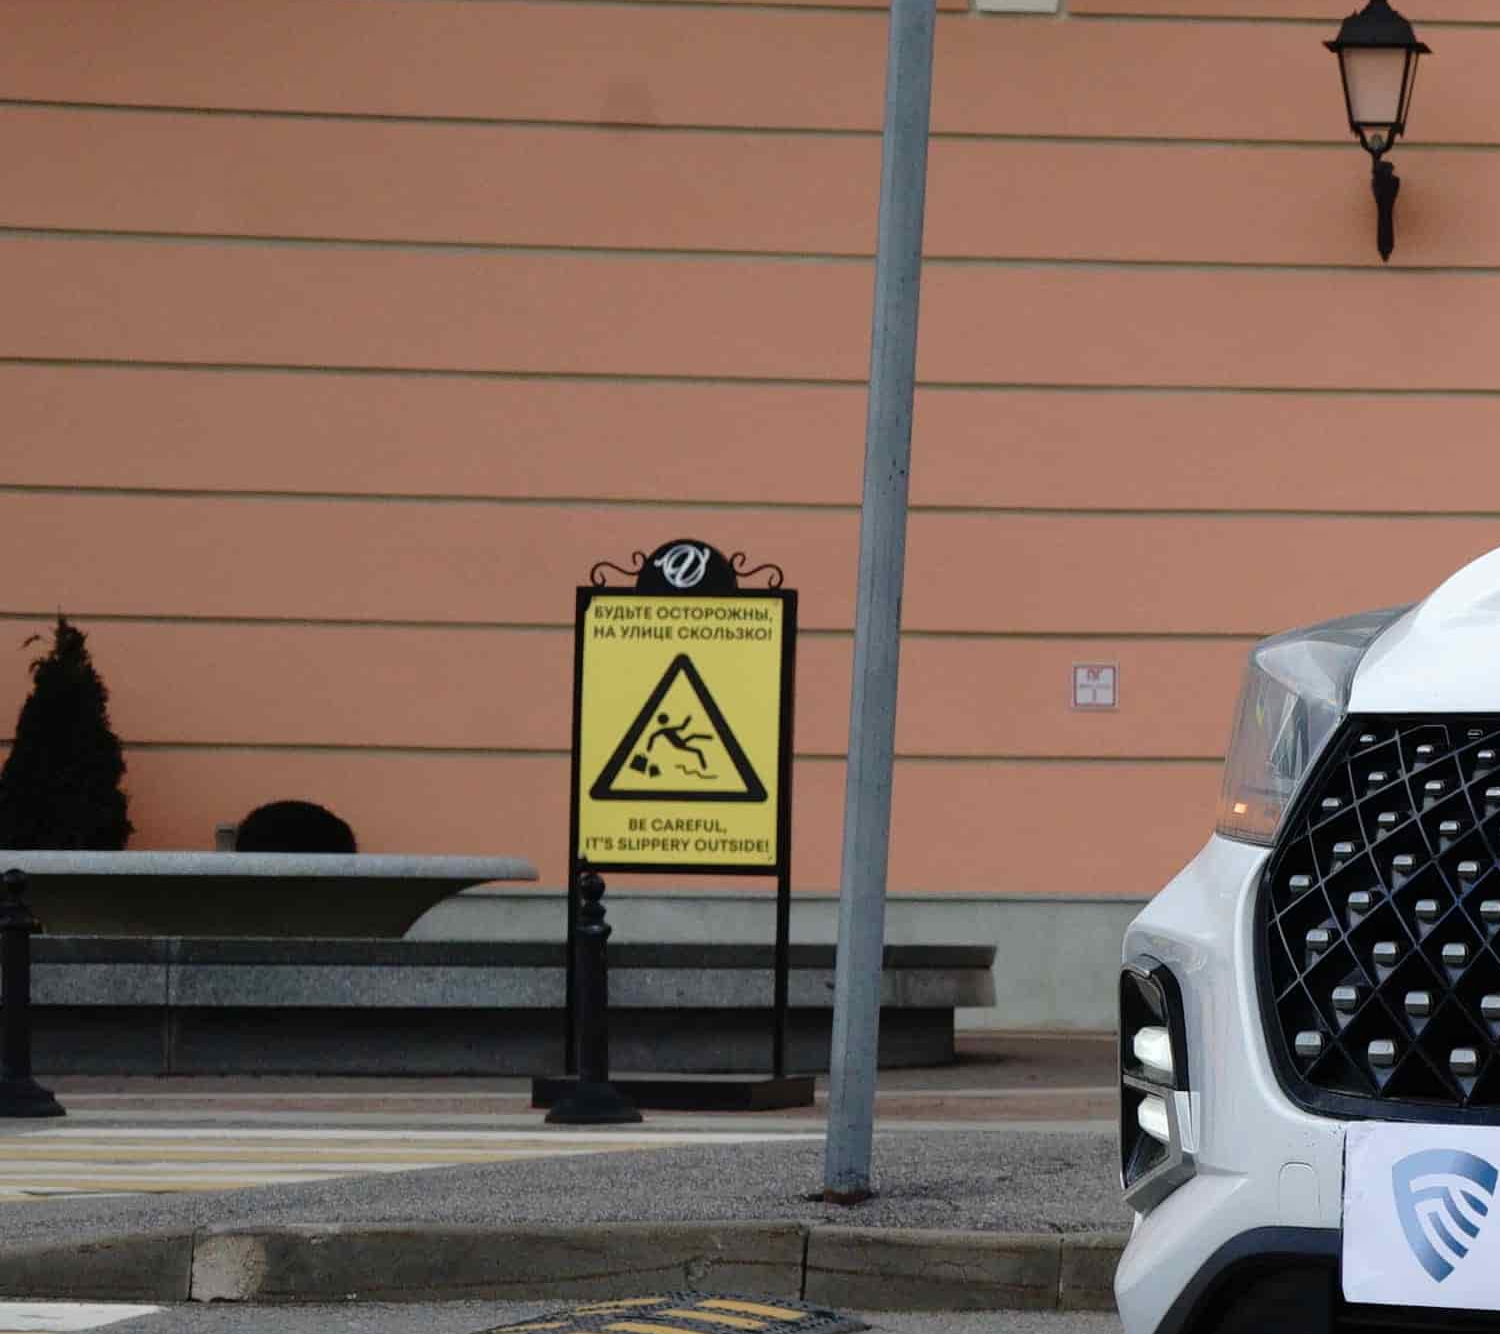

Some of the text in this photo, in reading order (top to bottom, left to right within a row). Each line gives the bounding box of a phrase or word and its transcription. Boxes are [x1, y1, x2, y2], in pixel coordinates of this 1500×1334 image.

[594, 606, 773, 623] БУДЬТЕ ОСТОРОЖНЫ,
[594, 626, 772, 641] НА УЛИЦЕ СКОЛЬЗКО!
[628, 818, 728, 835] BE CAREFUL,
[585, 837, 769, 853] IT'S SLIPPERY OUTSIDE!
